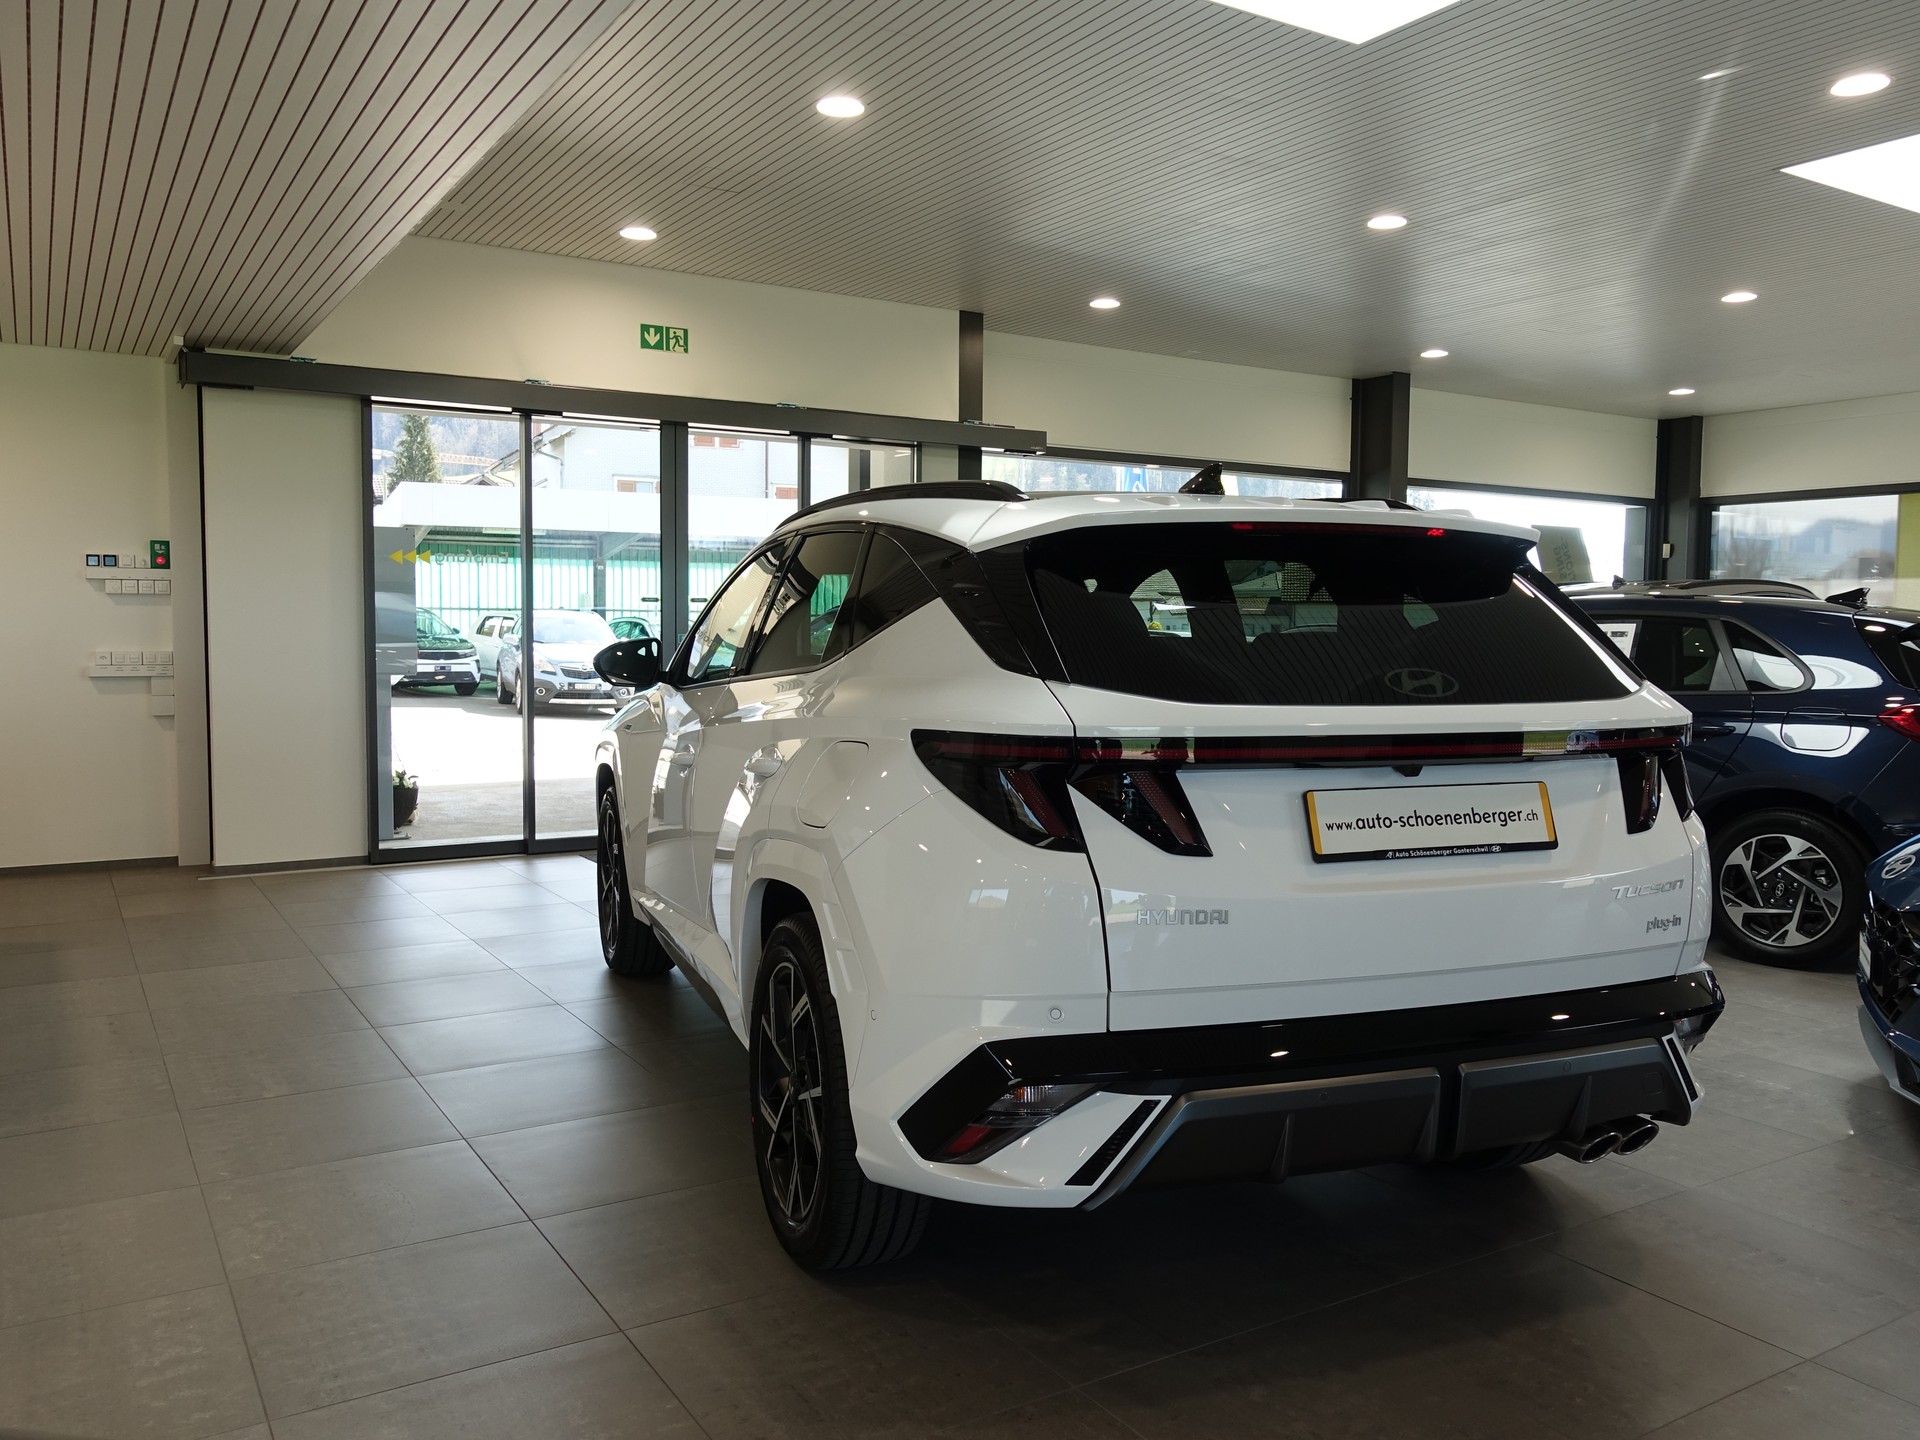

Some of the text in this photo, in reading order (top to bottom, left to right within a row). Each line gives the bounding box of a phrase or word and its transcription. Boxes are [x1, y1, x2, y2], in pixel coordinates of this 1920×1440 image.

[1325, 807, 1539, 832] www.auto-schoenenberger.ch
[1410, 848, 1452, 857] Schönenberger
[1611, 879, 1684, 899] TUCSON
[1136, 909, 1229, 925] HYUNDAI
[1645, 914, 1682, 933] plug-in
